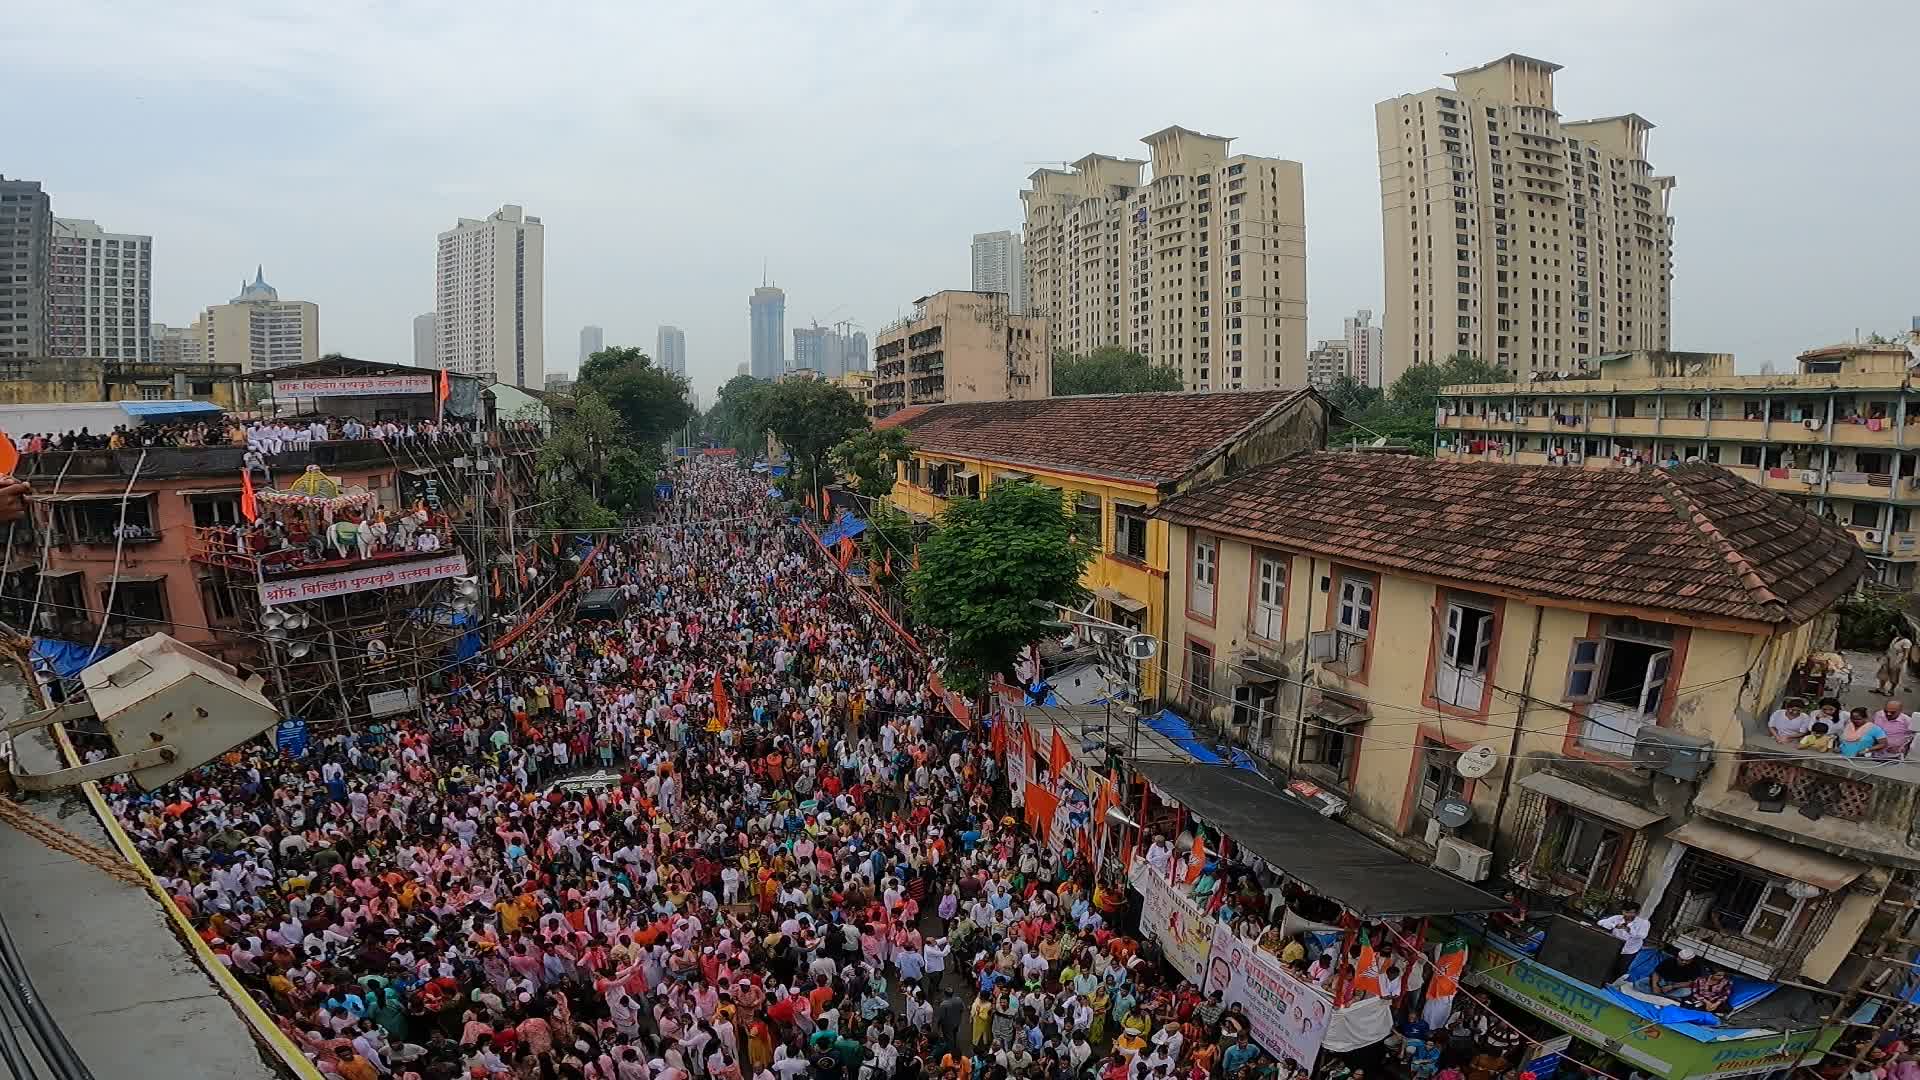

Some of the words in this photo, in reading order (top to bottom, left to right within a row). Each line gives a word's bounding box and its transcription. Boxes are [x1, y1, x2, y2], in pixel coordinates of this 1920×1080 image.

[266, 585, 297, 601] श्रॉफ
[301, 577, 348, 596] बिल्डिंग
[398, 566, 432, 581] उत्सव
[433, 562, 462, 575] मंडळ
